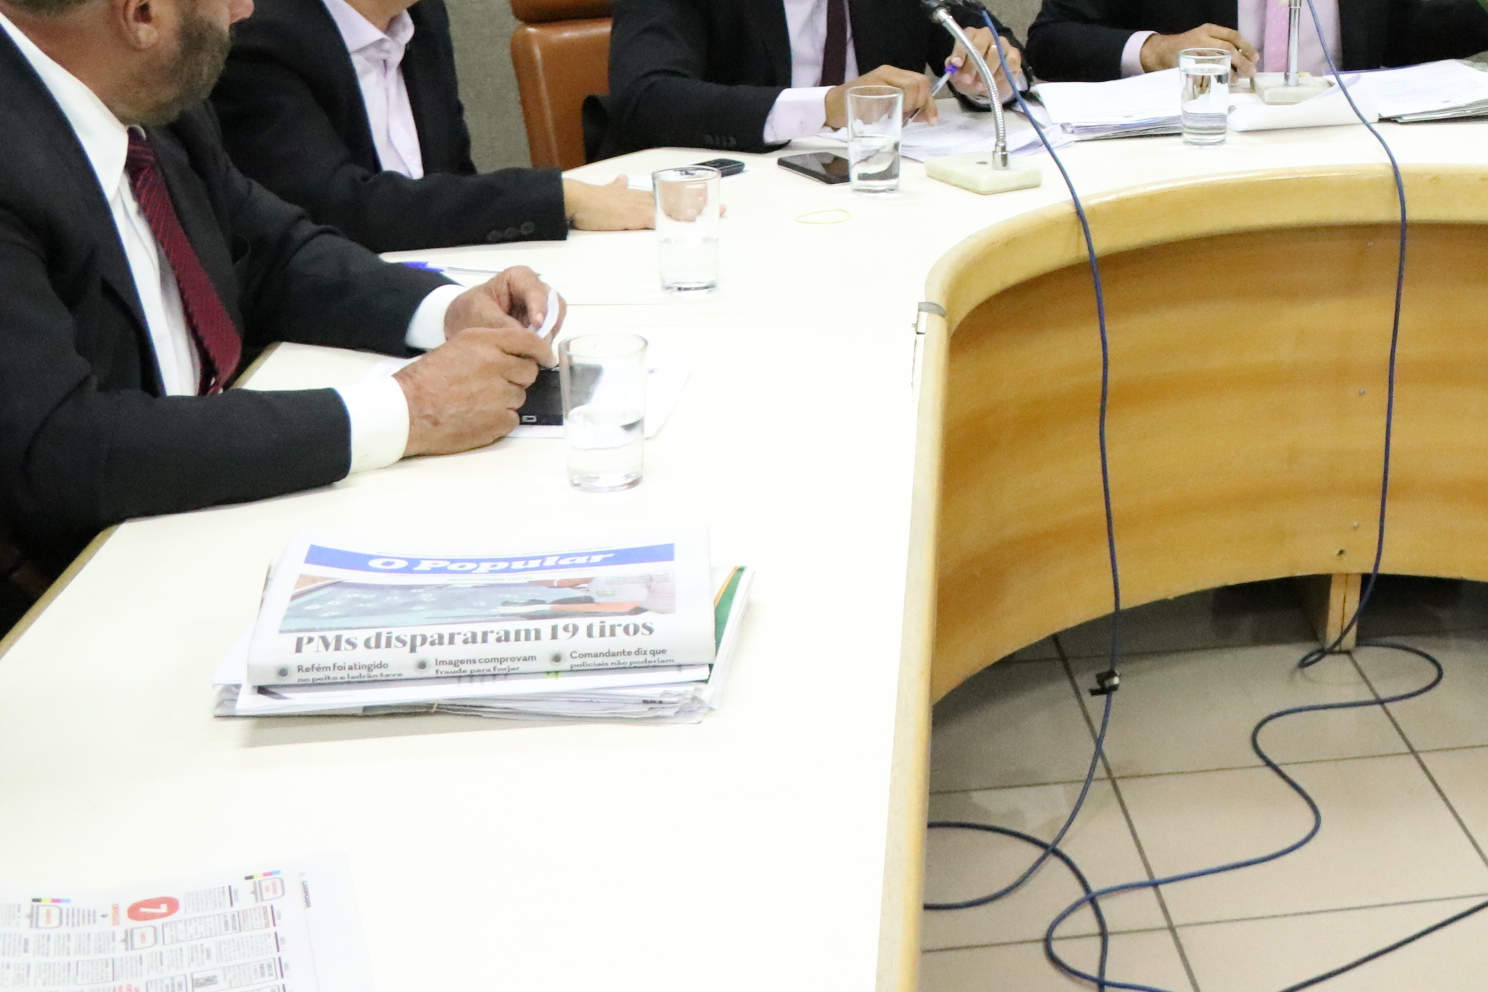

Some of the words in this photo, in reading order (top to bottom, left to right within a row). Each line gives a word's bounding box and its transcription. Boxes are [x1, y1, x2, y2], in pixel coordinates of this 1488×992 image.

[368, 558, 409, 570] O
[412, 553, 616, 573] Popular
[294, 634, 358, 653] PMs
[363, 627, 542, 653] dispararam
[549, 622, 580, 641] 19
[586, 620, 655, 639] tiros
[570, 649, 633, 659] Comandante
[634, 648, 649, 657] diz
[649, 647, 668, 657] que
[435, 658, 477, 668] Imagens
[478, 653, 537, 666] comprovam
[570, 661, 609, 669] policiais
[610, 659, 628, 667] não
[629, 658, 675, 667] poderiam
[297, 662, 334, 674] Refém
[333, 662, 347, 672] foi
[347, 661, 389, 673] atingido
[435, 667, 468, 676] fraude
[469, 667, 492, 676] para
[493, 665, 520, 673] forjar
[312, 674, 338, 683] peito
[347, 672, 378, 681] ladrão
[139, 903, 168, 914] 7
